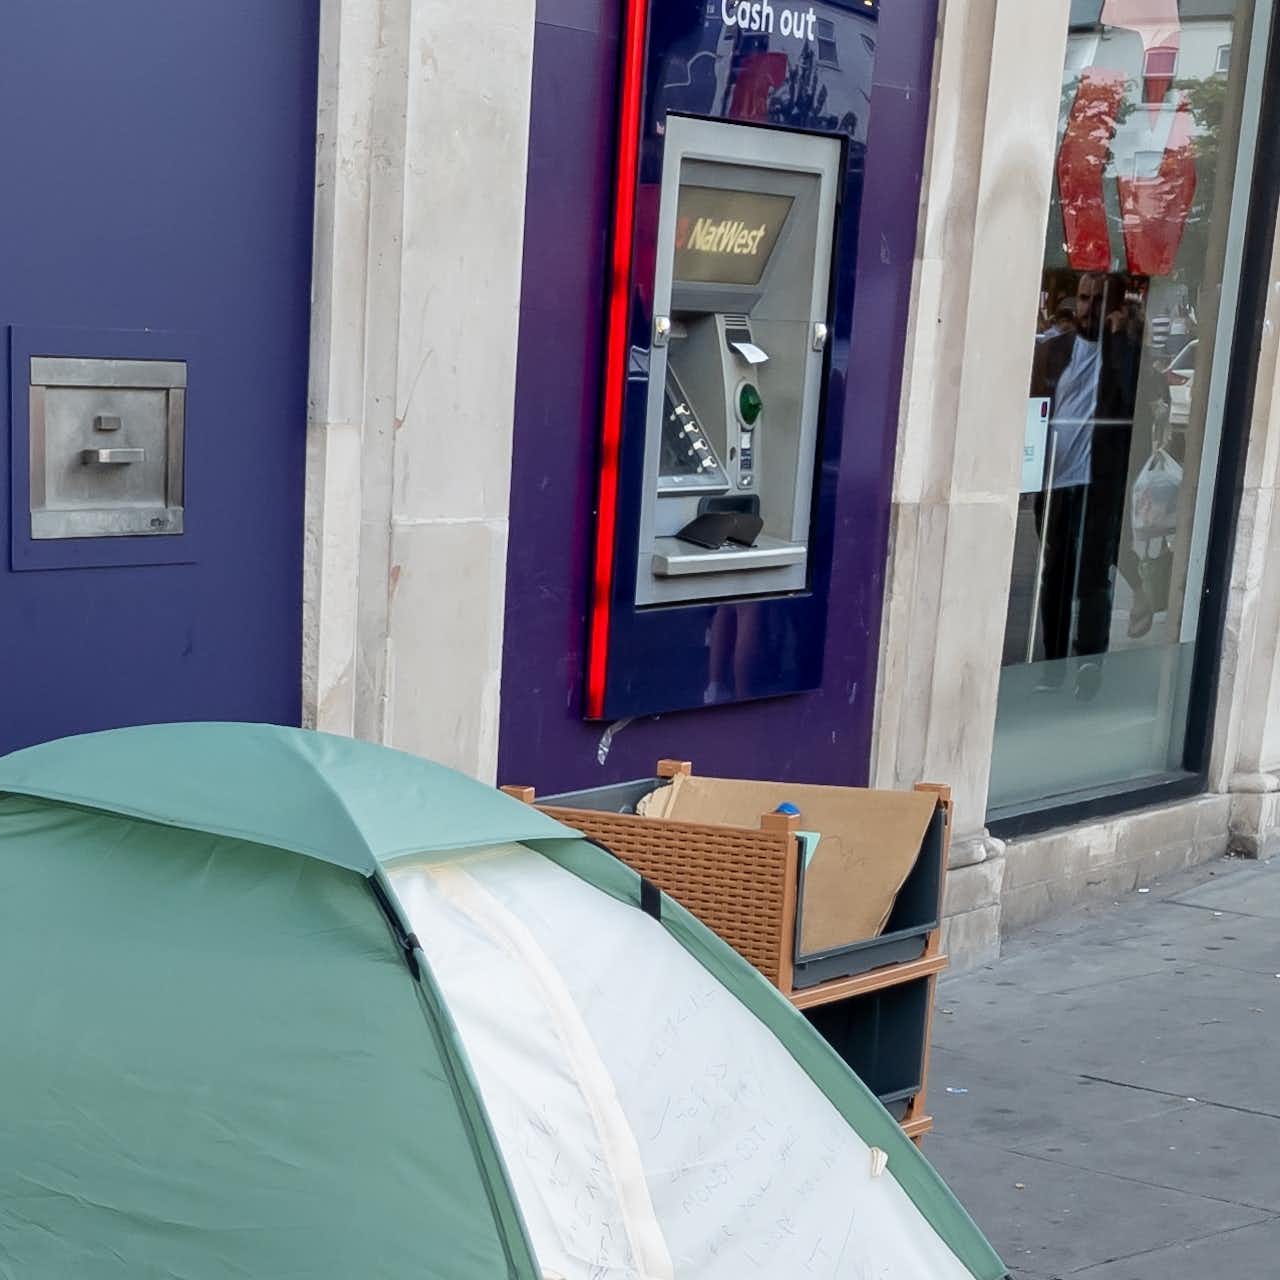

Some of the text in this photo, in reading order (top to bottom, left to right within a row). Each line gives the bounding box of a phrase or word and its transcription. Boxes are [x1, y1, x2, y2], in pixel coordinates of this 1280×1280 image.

[721, 0, 816, 41] Cash out
[687, 217, 766, 255] NatWest
